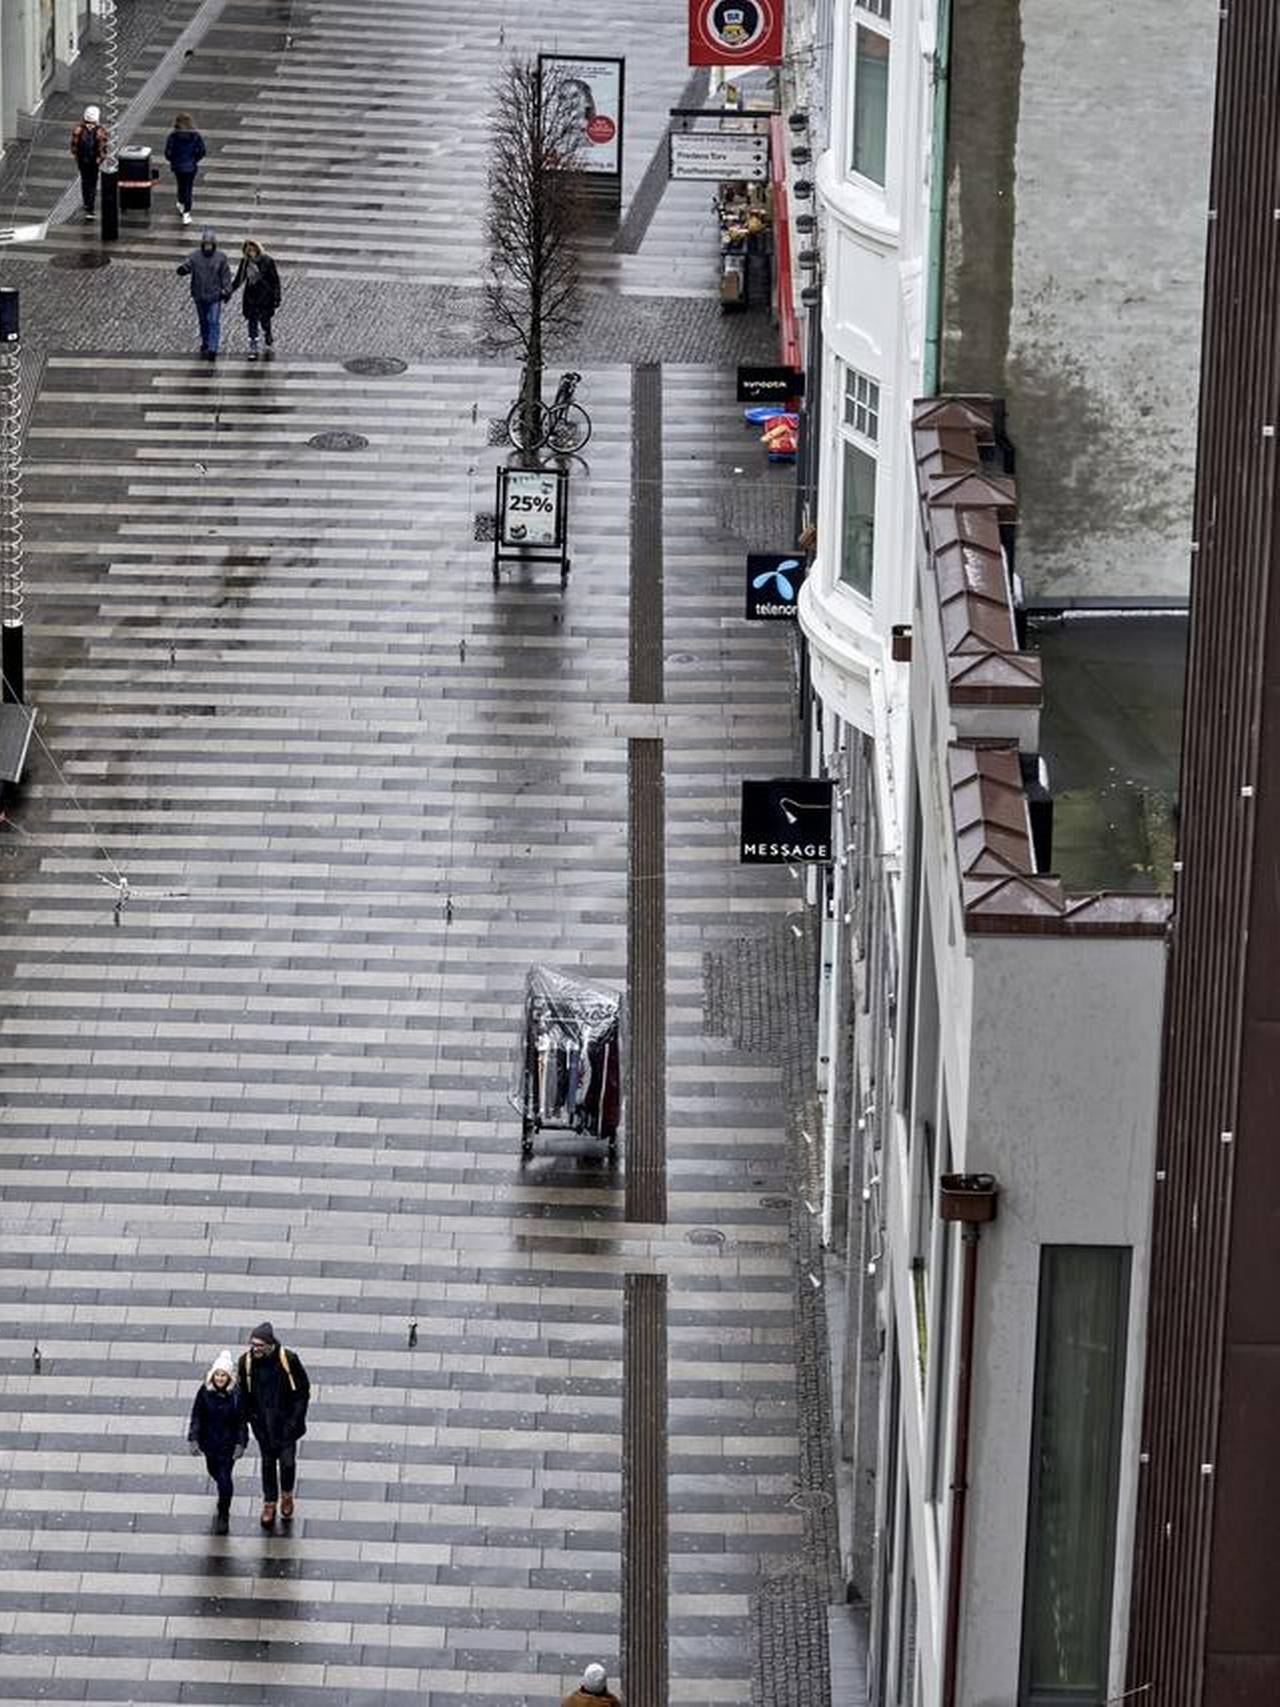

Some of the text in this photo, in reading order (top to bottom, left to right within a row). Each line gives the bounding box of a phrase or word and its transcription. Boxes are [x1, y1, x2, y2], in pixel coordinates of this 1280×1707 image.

[509, 494, 553, 513] 25%
[755, 602, 798, 616] telenor
[744, 843, 827, 857] MESSAGE
